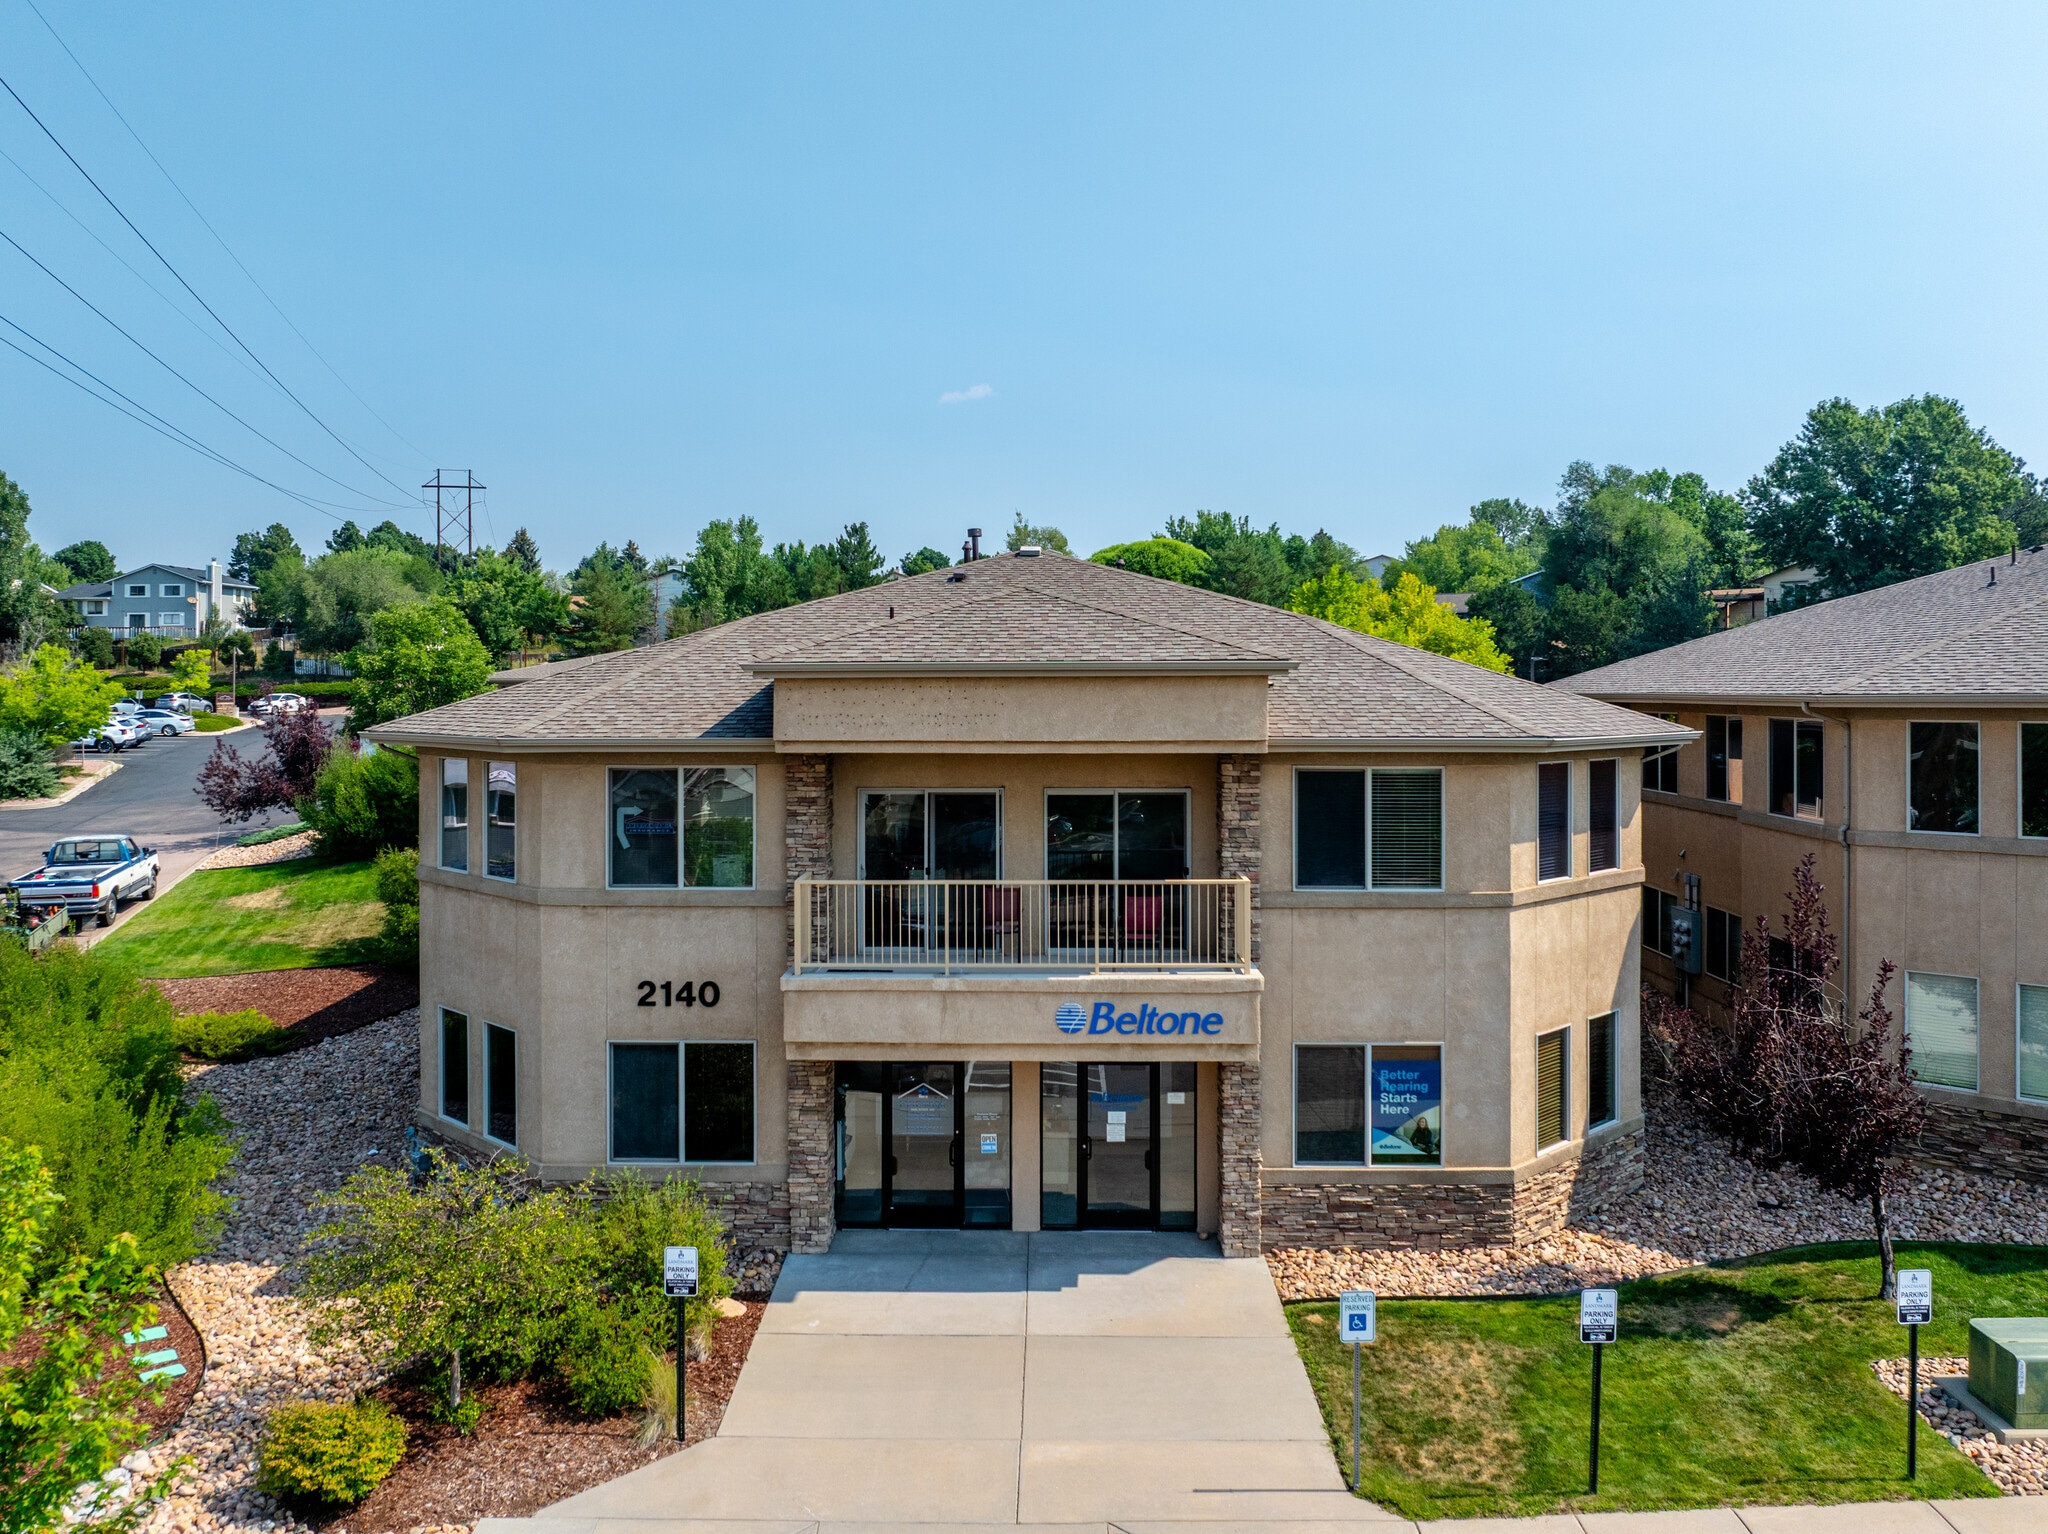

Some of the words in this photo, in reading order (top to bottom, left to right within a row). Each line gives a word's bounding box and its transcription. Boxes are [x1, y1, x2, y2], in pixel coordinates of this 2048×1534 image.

[637, 980, 721, 1008] 2140
[1087, 1002, 1224, 1035] Beltone
[1380, 1070, 1420, 1080] Better
[1380, 1081, 1429, 1093] Hearing
[1380, 1092, 1418, 1103] Starts
[1380, 1104, 1410, 1114] Here
[981, 1135, 996, 1143] OPEN
[1343, 1295, 1373, 1303] RESERVED
[1584, 1310, 1614, 1318] PARKING
[1590, 1317, 1608, 1325] ONLY
